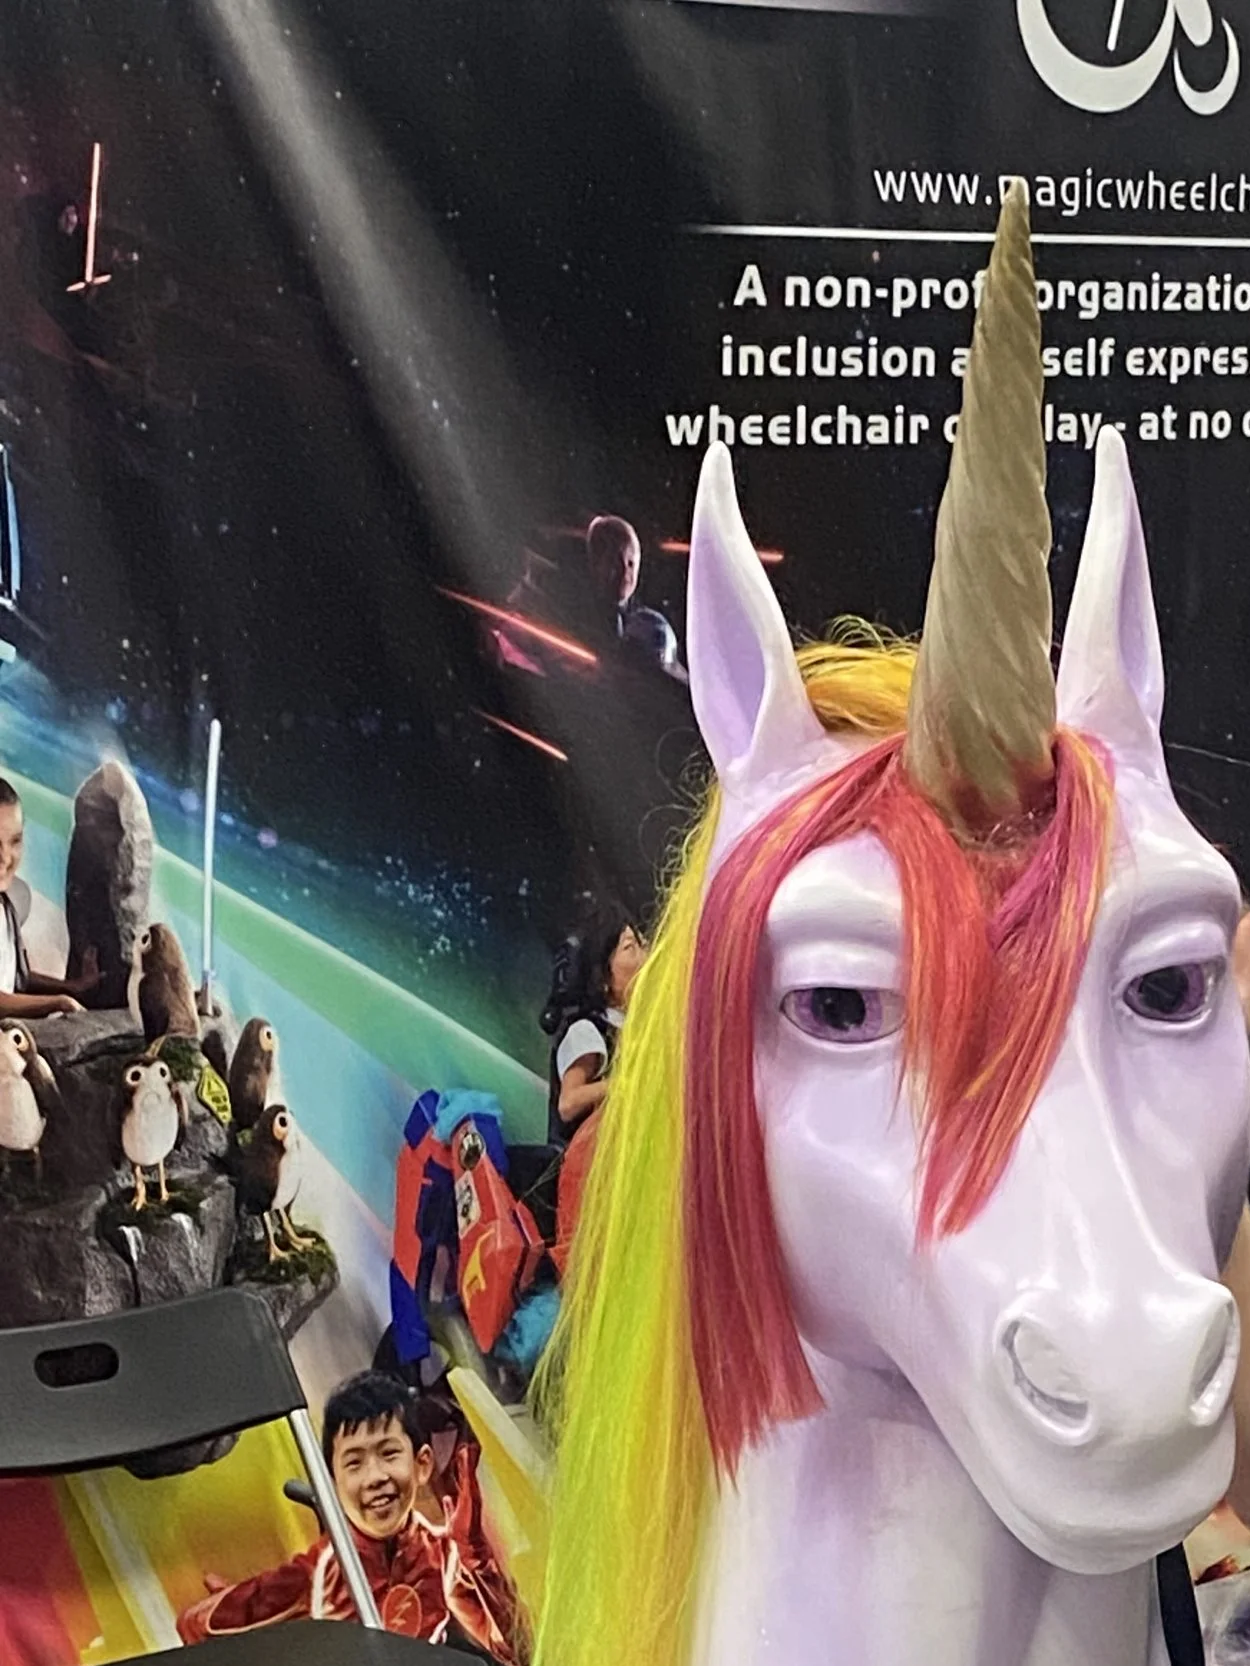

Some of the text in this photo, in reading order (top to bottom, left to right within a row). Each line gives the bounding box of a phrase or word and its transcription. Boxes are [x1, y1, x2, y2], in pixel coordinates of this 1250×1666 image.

[733, 264, 768, 307] A
[784, 268, 988, 318] non-prof
[721, 334, 937, 378] inclusion
[1042, 337, 1116, 377] self
[665, 404, 930, 446] wheelchair
[1139, 404, 1178, 440] at
[1189, 410, 1232, 439] no
